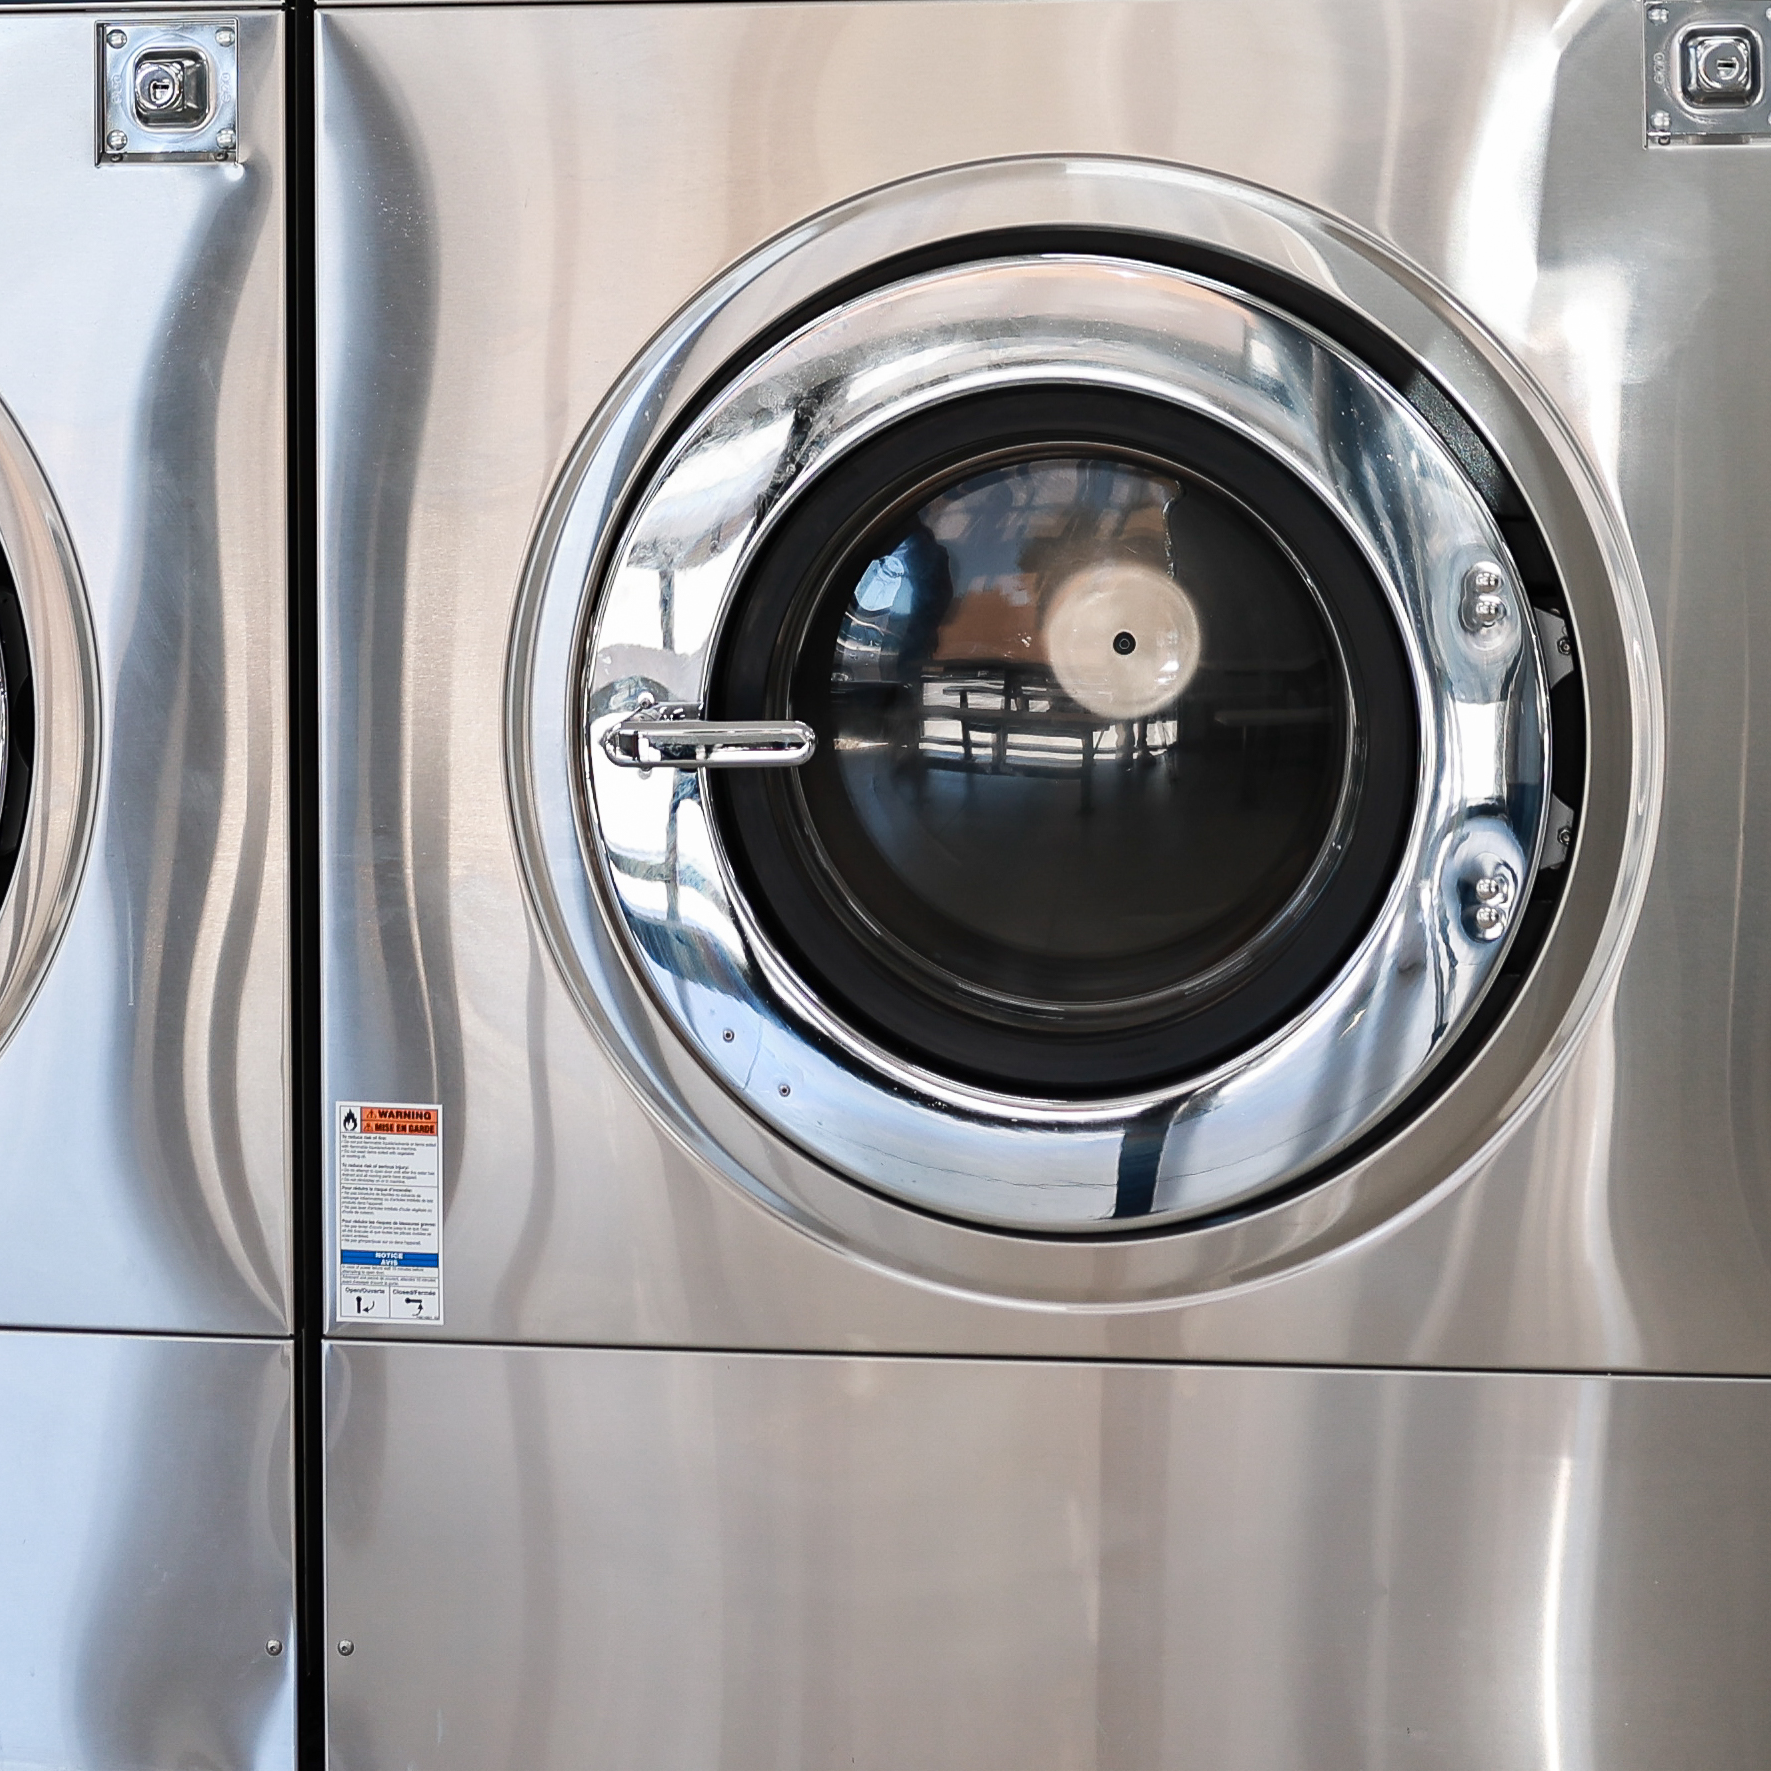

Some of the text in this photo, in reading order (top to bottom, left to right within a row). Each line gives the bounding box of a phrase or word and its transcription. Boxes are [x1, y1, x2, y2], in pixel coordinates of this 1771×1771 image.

[378, 1110, 432, 1120] WARNING
[374, 1123, 435, 1134] MISE EN GARDE
[375, 1252, 404, 1260] NOTICE
